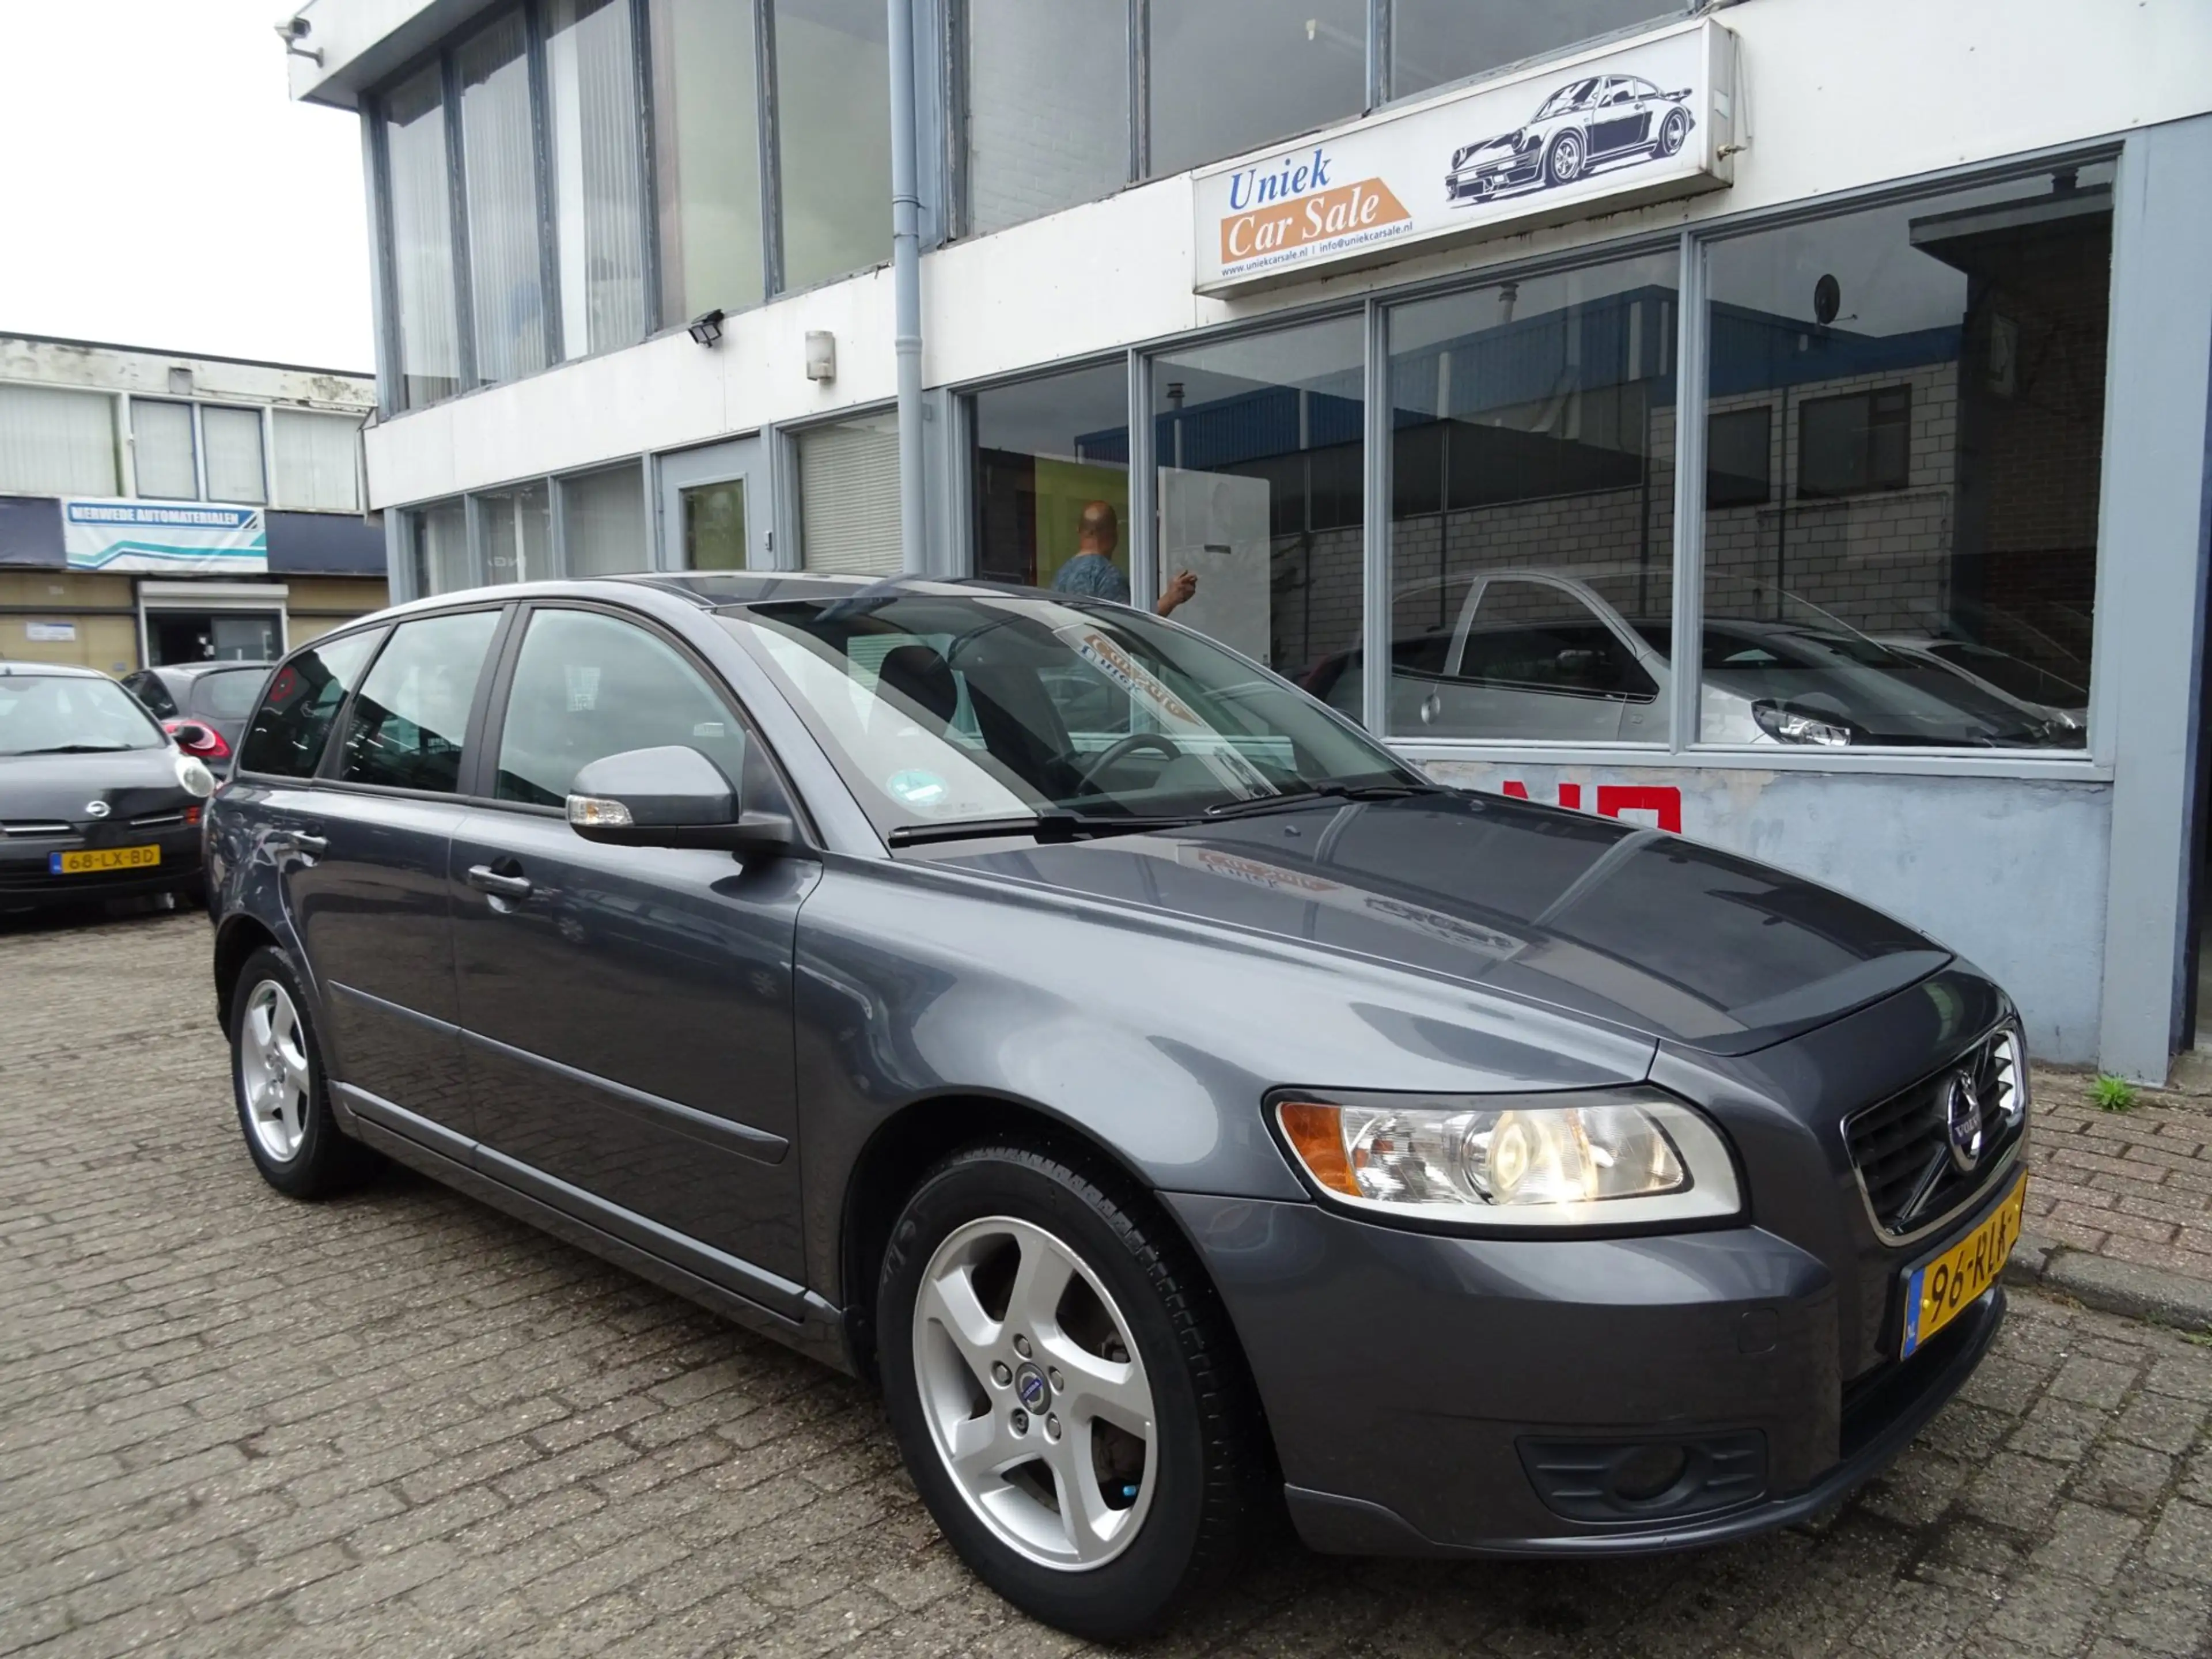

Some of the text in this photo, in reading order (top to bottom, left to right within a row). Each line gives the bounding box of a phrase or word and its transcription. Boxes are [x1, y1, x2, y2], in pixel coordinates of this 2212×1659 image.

[1230, 149, 1332, 210] Uniek
[1221, 248, 1308, 276] www.uniekcarsale.nl
[1319, 222, 1413, 253] info@uniekcarsale.nl
[1229, 186, 1380, 256] Car Sale
[69, 849, 154, 870] 68-LX-BD
